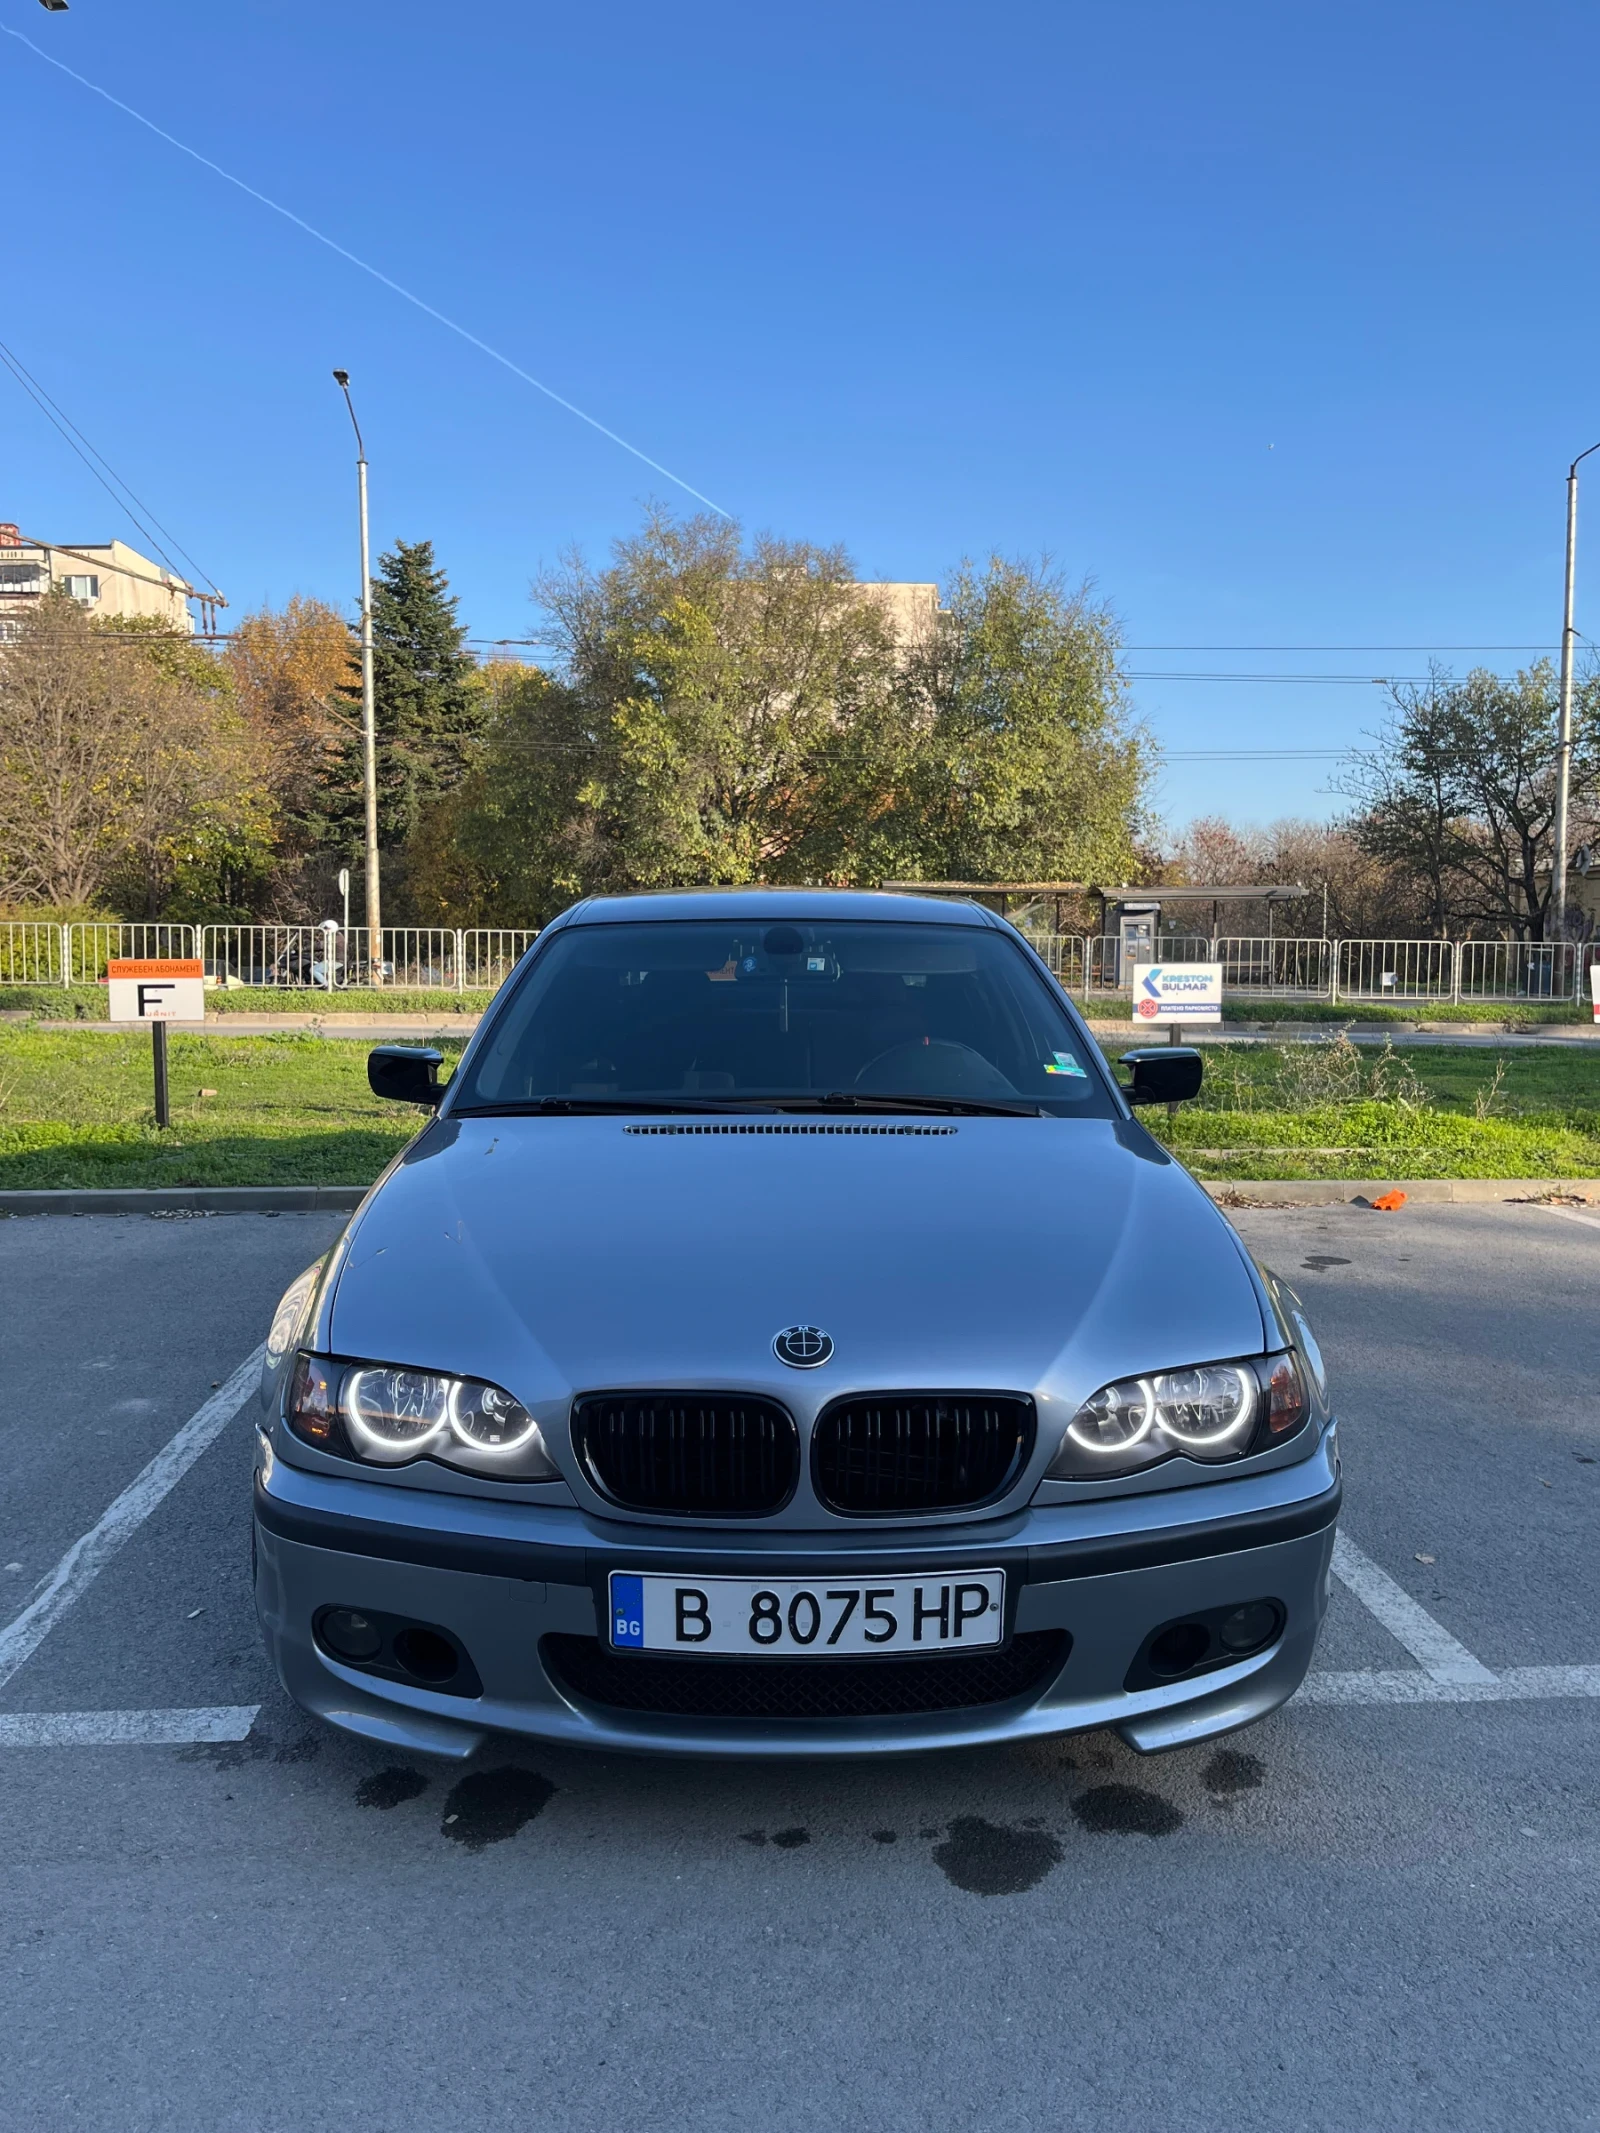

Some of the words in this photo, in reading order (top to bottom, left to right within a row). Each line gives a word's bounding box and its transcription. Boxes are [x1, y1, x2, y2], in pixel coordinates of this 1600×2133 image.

[111, 965, 153, 974] СЛУЖЕБЕН
[154, 964, 200, 974] АБОНАМЕНТ
[1162, 974, 1214, 983] KRESTON
[1162, 983, 1208, 991] BULMAR
[674, 1587, 712, 1643] B
[748, 1588, 898, 1645] 8075
[912, 1582, 991, 1642] HP
[616, 1618, 641, 1637] BG
